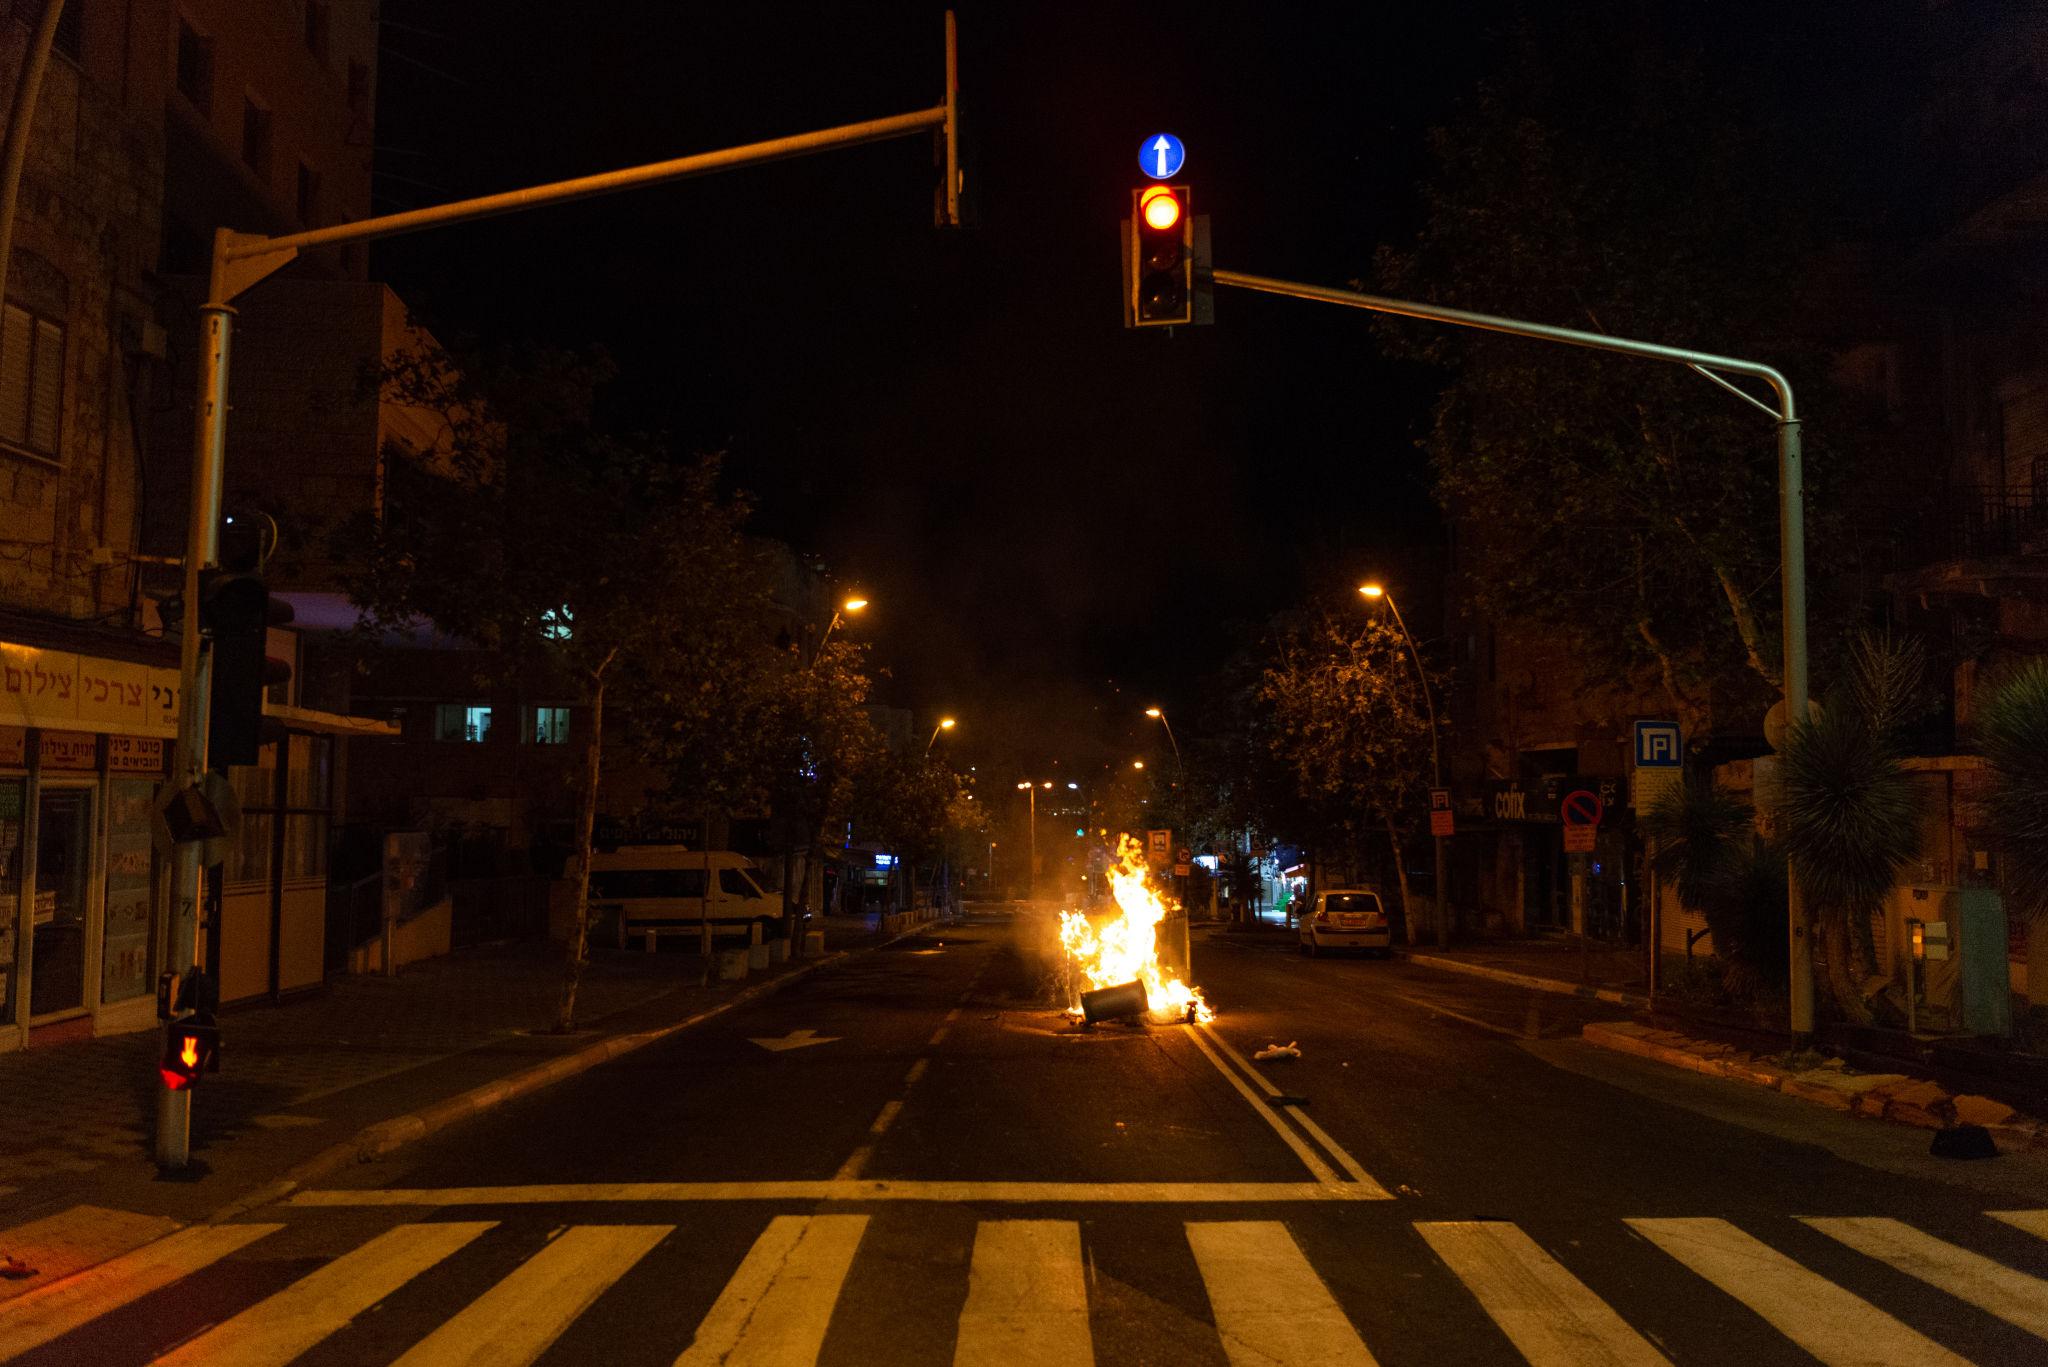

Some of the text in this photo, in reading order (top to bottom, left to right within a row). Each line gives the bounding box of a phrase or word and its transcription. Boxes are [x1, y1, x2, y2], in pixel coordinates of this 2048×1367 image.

[4, 662, 71, 699] צילום
[84, 675, 142, 706] צרכי
[72, 741, 96, 758] חנות
[110, 738, 160, 753] פוטו פיני
[122, 755, 160, 767] הנביאים
[1495, 782, 1526, 819] cofix
